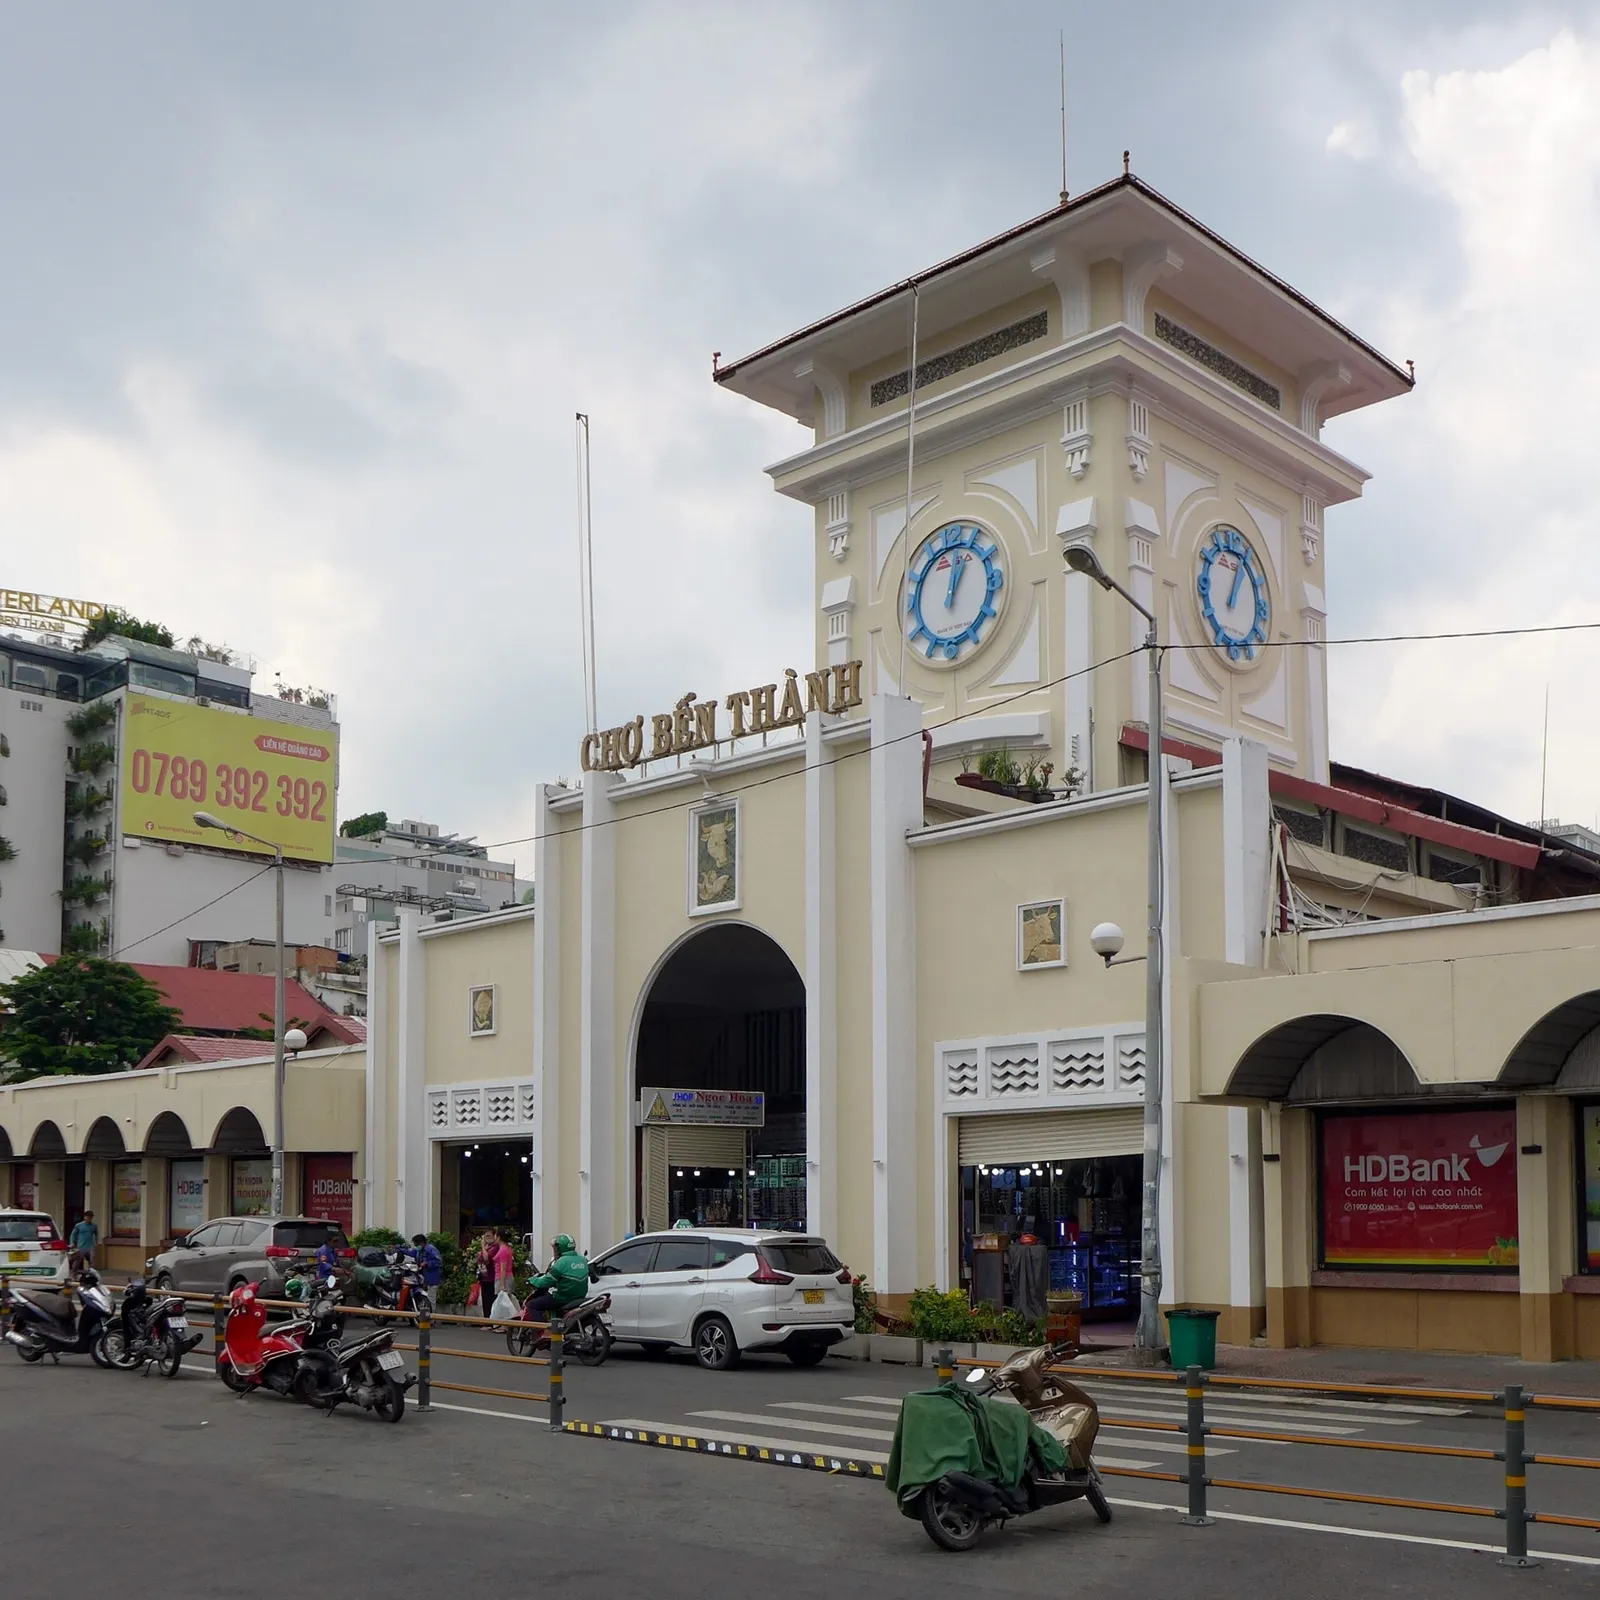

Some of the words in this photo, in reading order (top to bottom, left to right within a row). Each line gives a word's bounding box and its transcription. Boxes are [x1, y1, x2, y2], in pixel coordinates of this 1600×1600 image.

[939, 525, 962, 549] 12
[1225, 530, 1245, 556] 12
[0, 589, 105, 620] ERLAND
[580, 714, 644, 772] CHỢ
[651, 692, 718, 757] BẾN
[726, 660, 863, 737] THÀNH
[132, 749, 207, 803] 0789
[215, 763, 269, 814] 392
[276, 775, 328, 823] 392
[728, 1093, 753, 1104] Hoa
[1344, 1153, 1471, 1183] HDBank
[312, 1179, 353, 1195] HDBank
[1345, 1187, 1366, 1197] Cam
[1371, 1186, 1389, 1197] kết
[1393, 1186, 1407, 1199] lợi
[1411, 1186, 1427, 1197] ích
[1432, 1188, 1452, 1197] cao
[1456, 1185, 1484, 1197] nhất
[1352, 1203, 1367, 1211] 1900
[1368, 1203, 1385, 1211] 6060
[570, 1262, 585, 1270] Grab
